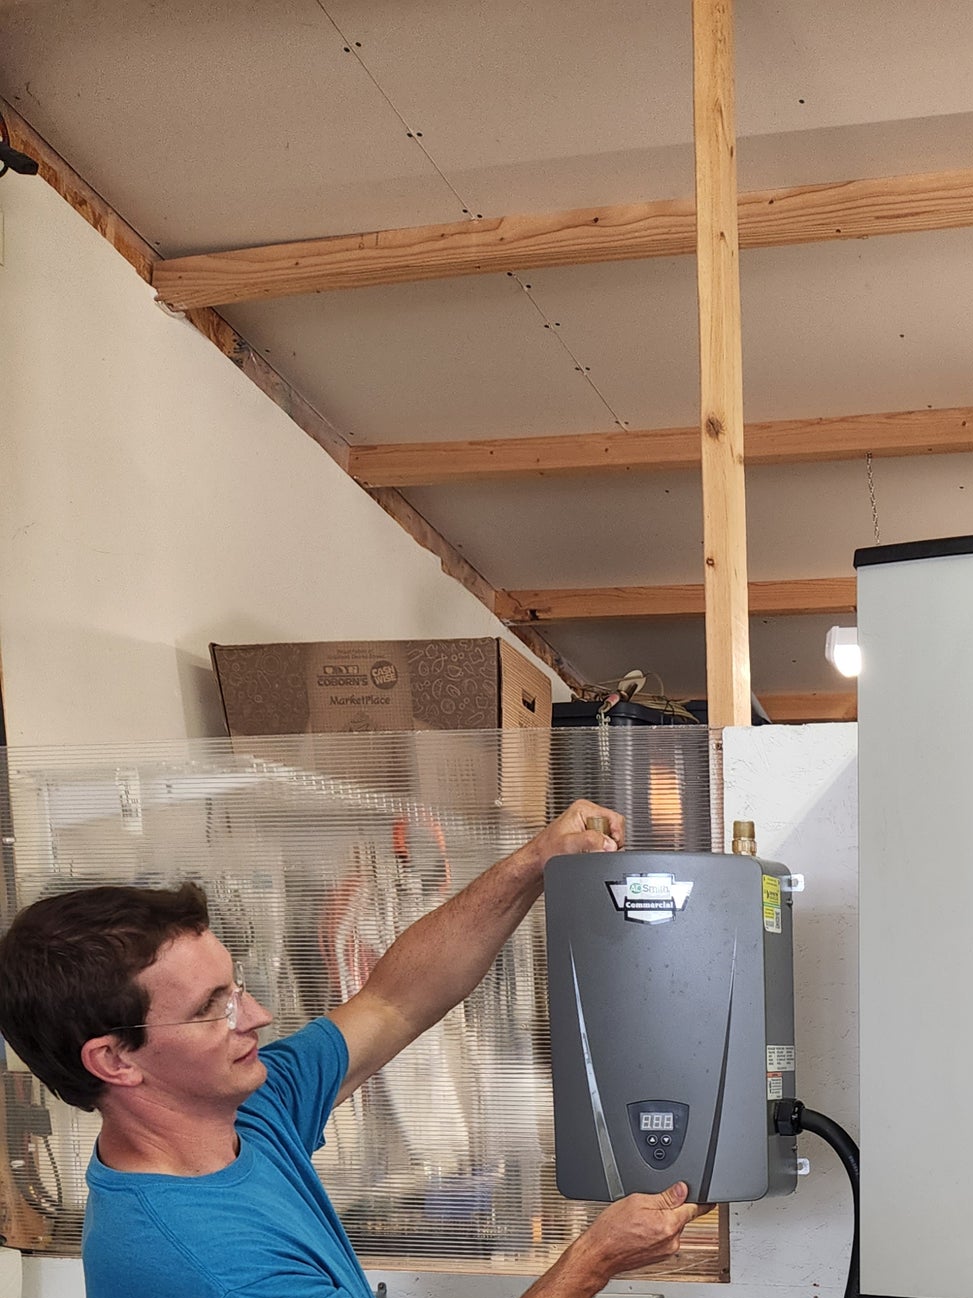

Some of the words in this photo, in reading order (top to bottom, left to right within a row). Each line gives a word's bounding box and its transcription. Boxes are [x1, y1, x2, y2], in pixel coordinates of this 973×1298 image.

[372, 665, 395, 676] CASH
[317, 677, 368, 687] COBORN'S
[374, 674, 397, 685] WISE
[330, 694, 391, 705] MarketPlace
[625, 901, 673, 909] Commercial
